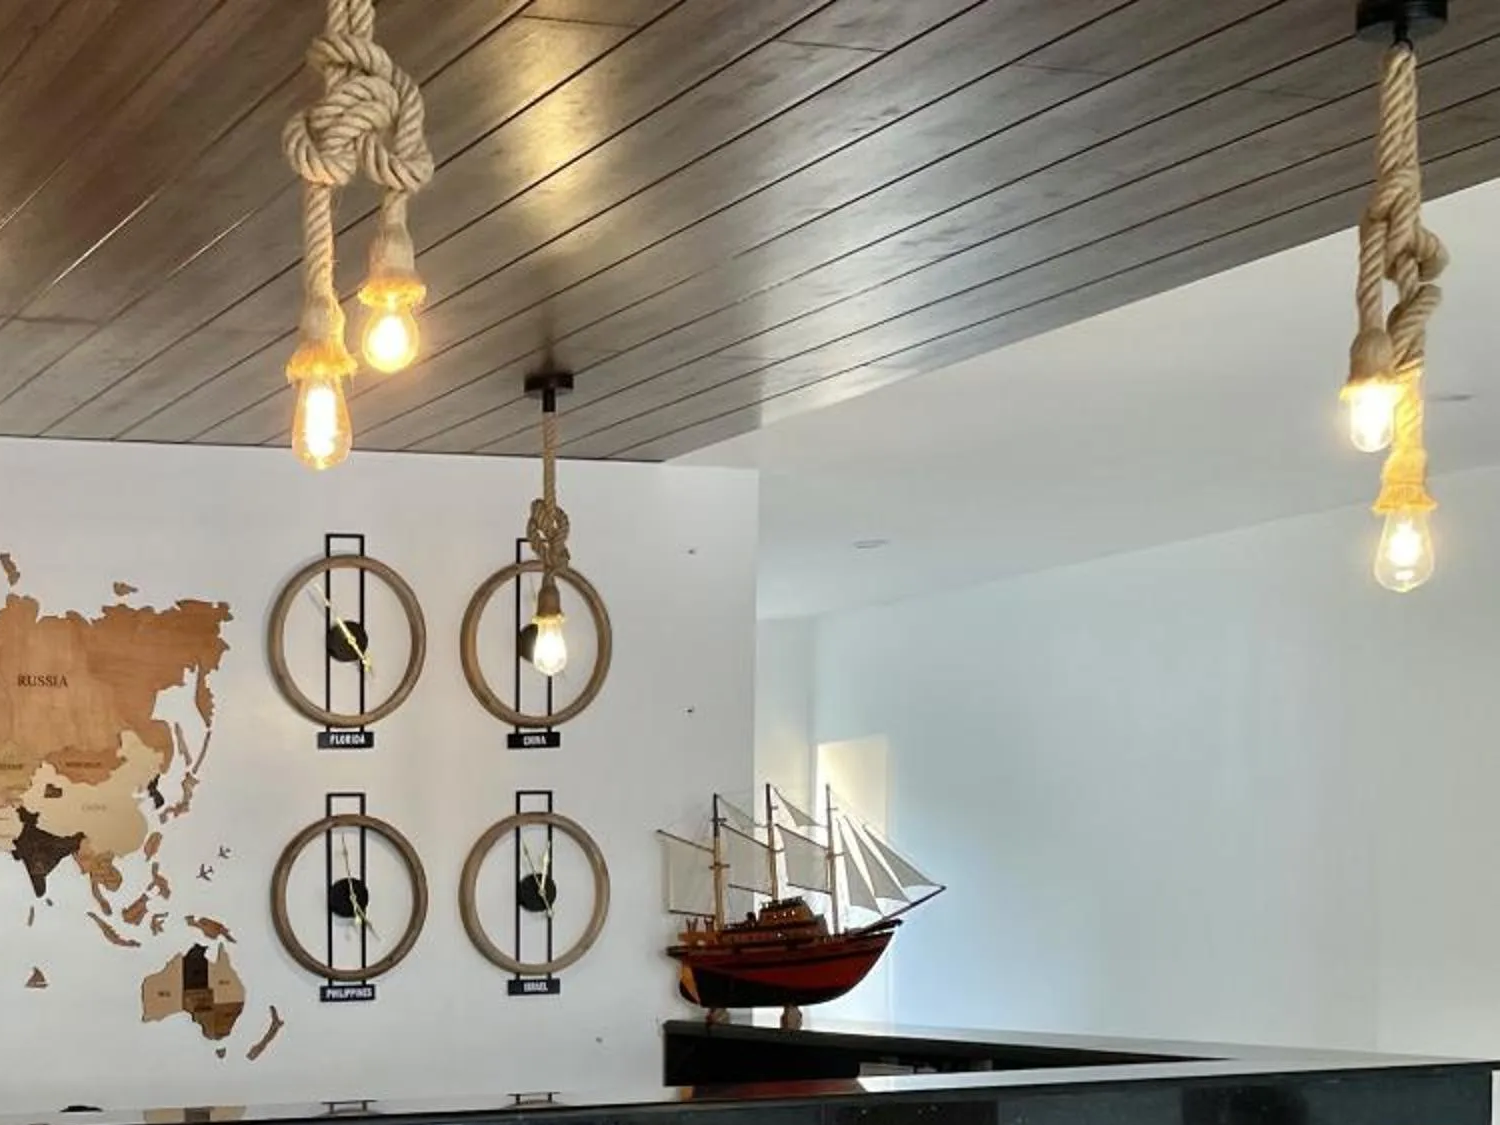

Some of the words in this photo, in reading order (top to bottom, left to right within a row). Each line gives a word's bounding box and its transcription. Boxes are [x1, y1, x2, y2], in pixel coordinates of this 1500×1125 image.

[17, 673, 69, 688] RUSSIA
[329, 733, 366, 746] FLORIDA
[326, 987, 373, 999] PHILIPPINES
